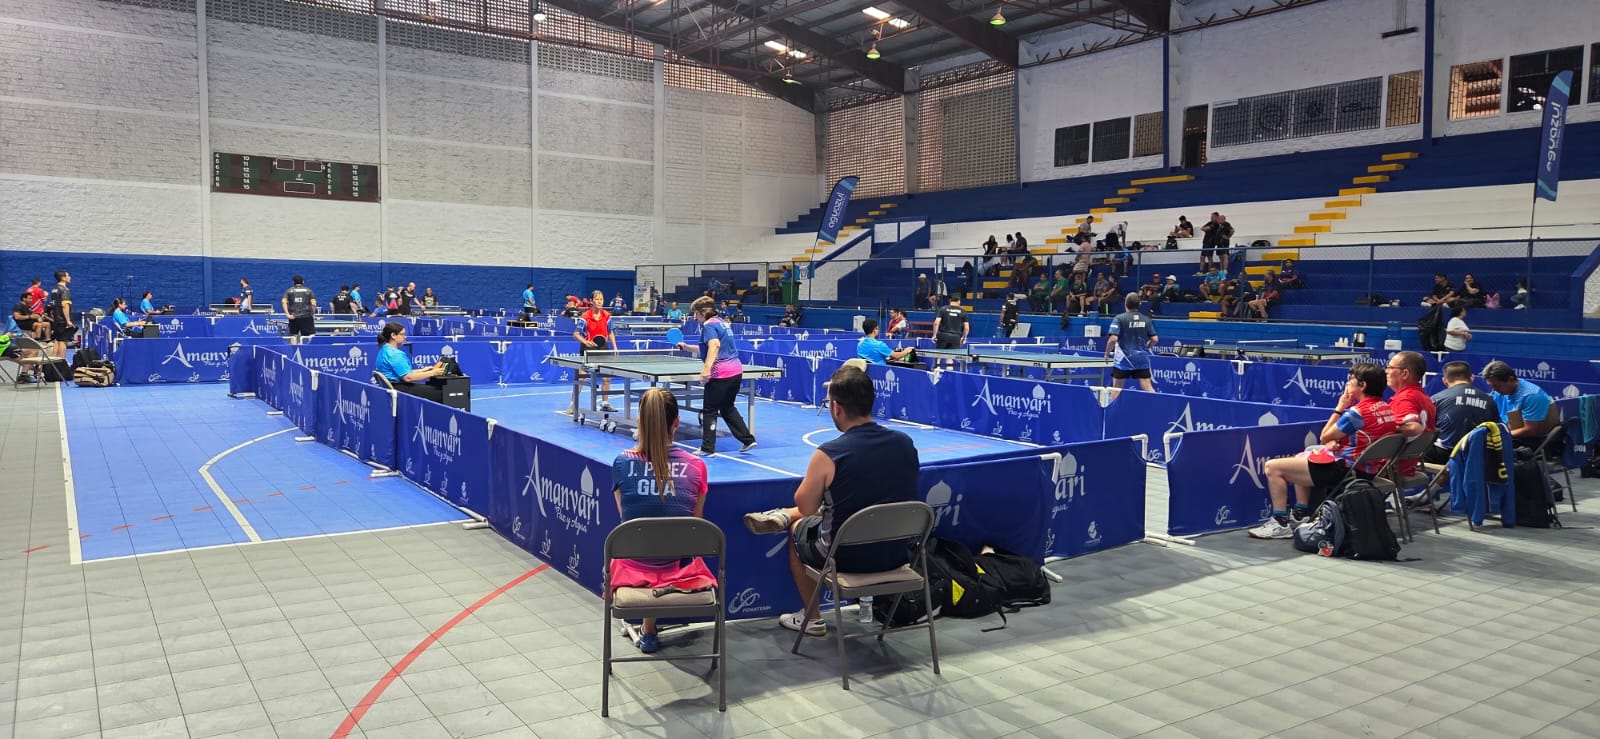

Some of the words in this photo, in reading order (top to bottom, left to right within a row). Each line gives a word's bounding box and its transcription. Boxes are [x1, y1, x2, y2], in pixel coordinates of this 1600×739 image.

[161, 342, 228, 368] Amanv
[1150, 367, 1201, 384] manvari
[1283, 367, 1346, 396] Amanv
[972, 377, 1052, 416] Amanvari
[413, 403, 462, 456] Amanvari
[627, 460, 638, 478] J.
[644, 461, 689, 478] PEZ
[522, 444, 600, 525] Amanvari
[637, 478, 676, 497] GUA
